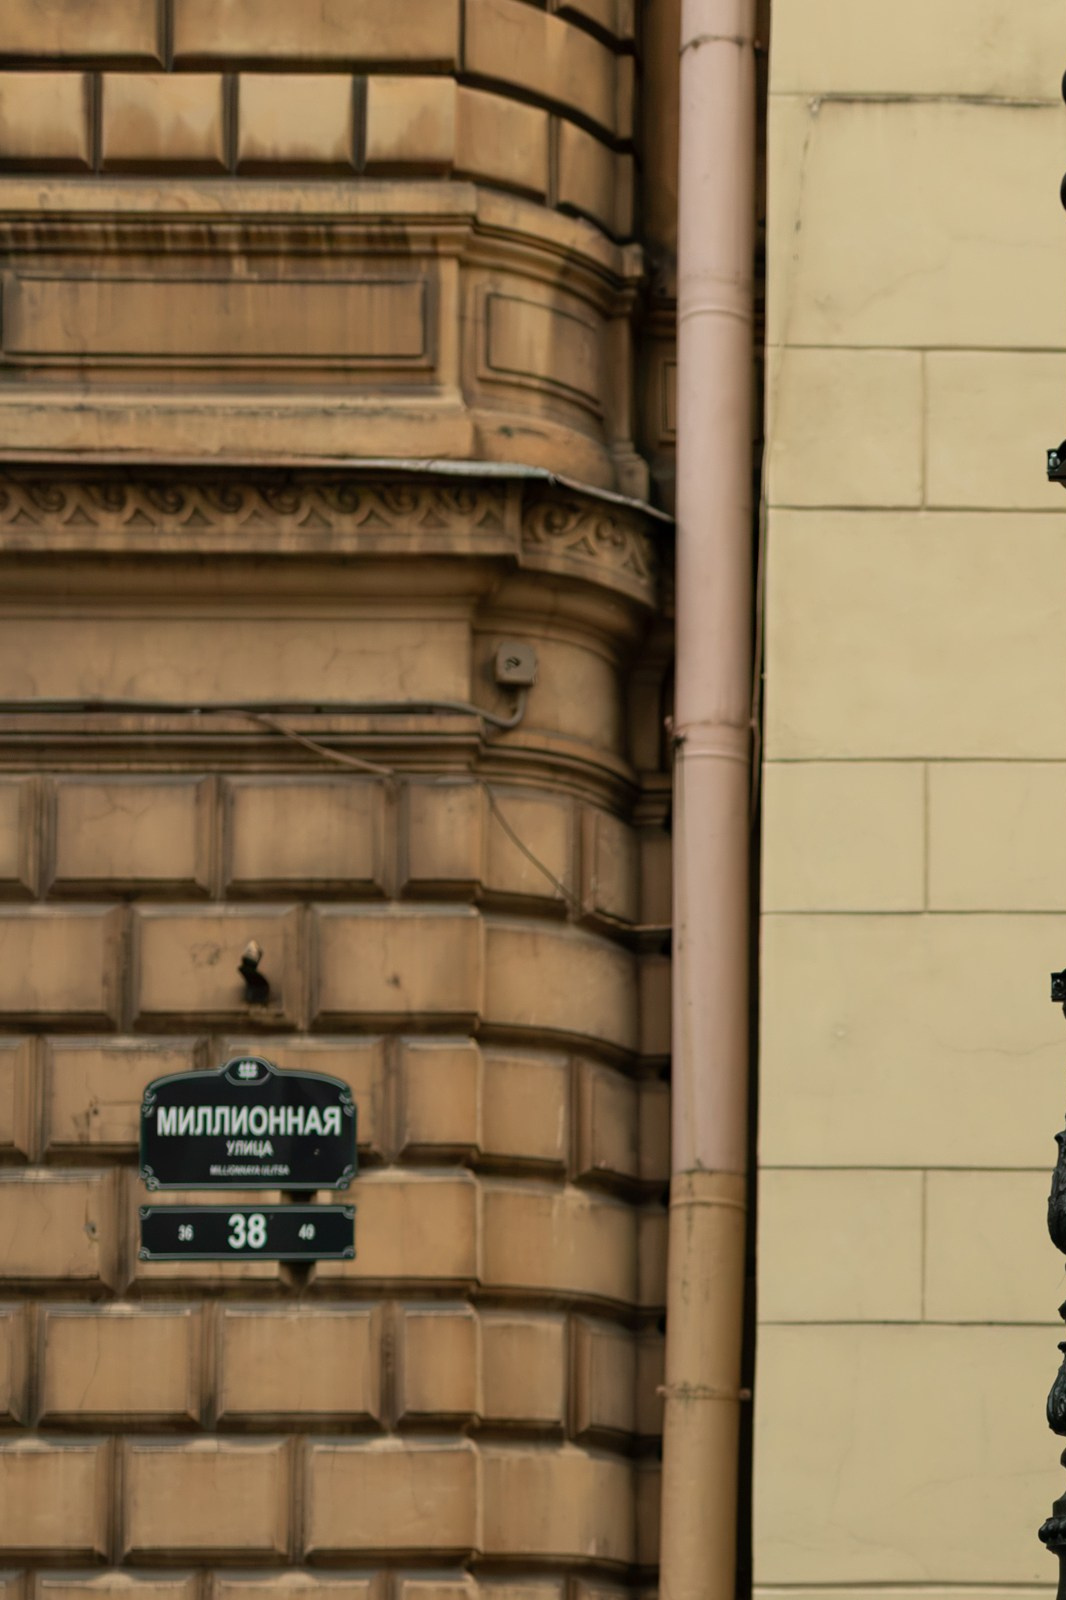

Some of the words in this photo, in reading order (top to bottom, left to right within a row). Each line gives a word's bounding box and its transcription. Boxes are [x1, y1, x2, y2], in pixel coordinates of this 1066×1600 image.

[157, 1106, 341, 1136] МИЛЛИОННАЯ
[226, 1140, 273, 1158] УЛИЦА
[178, 1224, 194, 1241] 36
[227, 1213, 267, 1249] 38
[298, 1224, 315, 1240] 40
